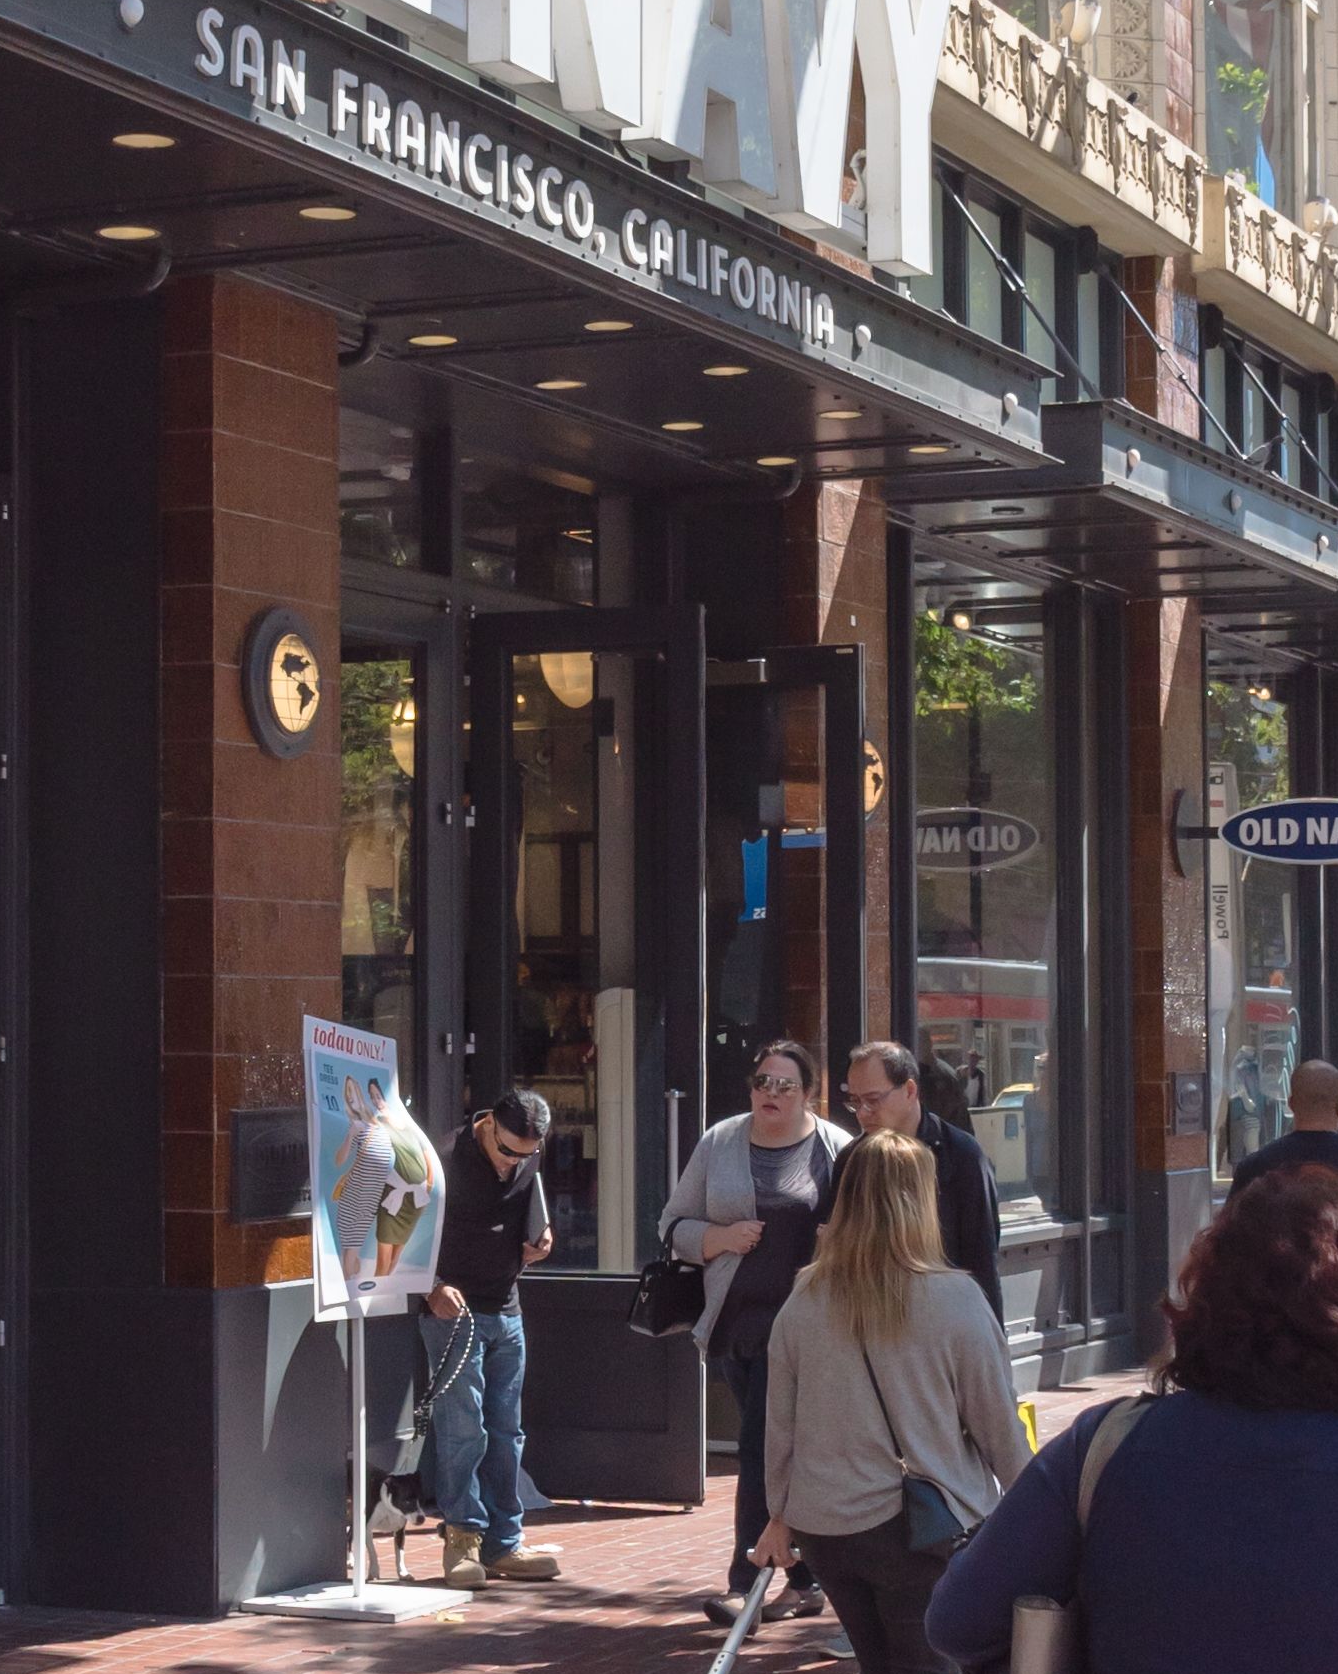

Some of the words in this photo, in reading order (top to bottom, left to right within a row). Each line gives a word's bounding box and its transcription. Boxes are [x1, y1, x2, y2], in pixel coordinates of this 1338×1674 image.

[194, 6, 306, 117] SAN
[331, 67, 607, 256] FRANCISCO,
[622, 207, 835, 346] CALIFORNIA
[1239, 818, 1299, 846] OLD
[356, 1040, 386, 1062] ONLY!
